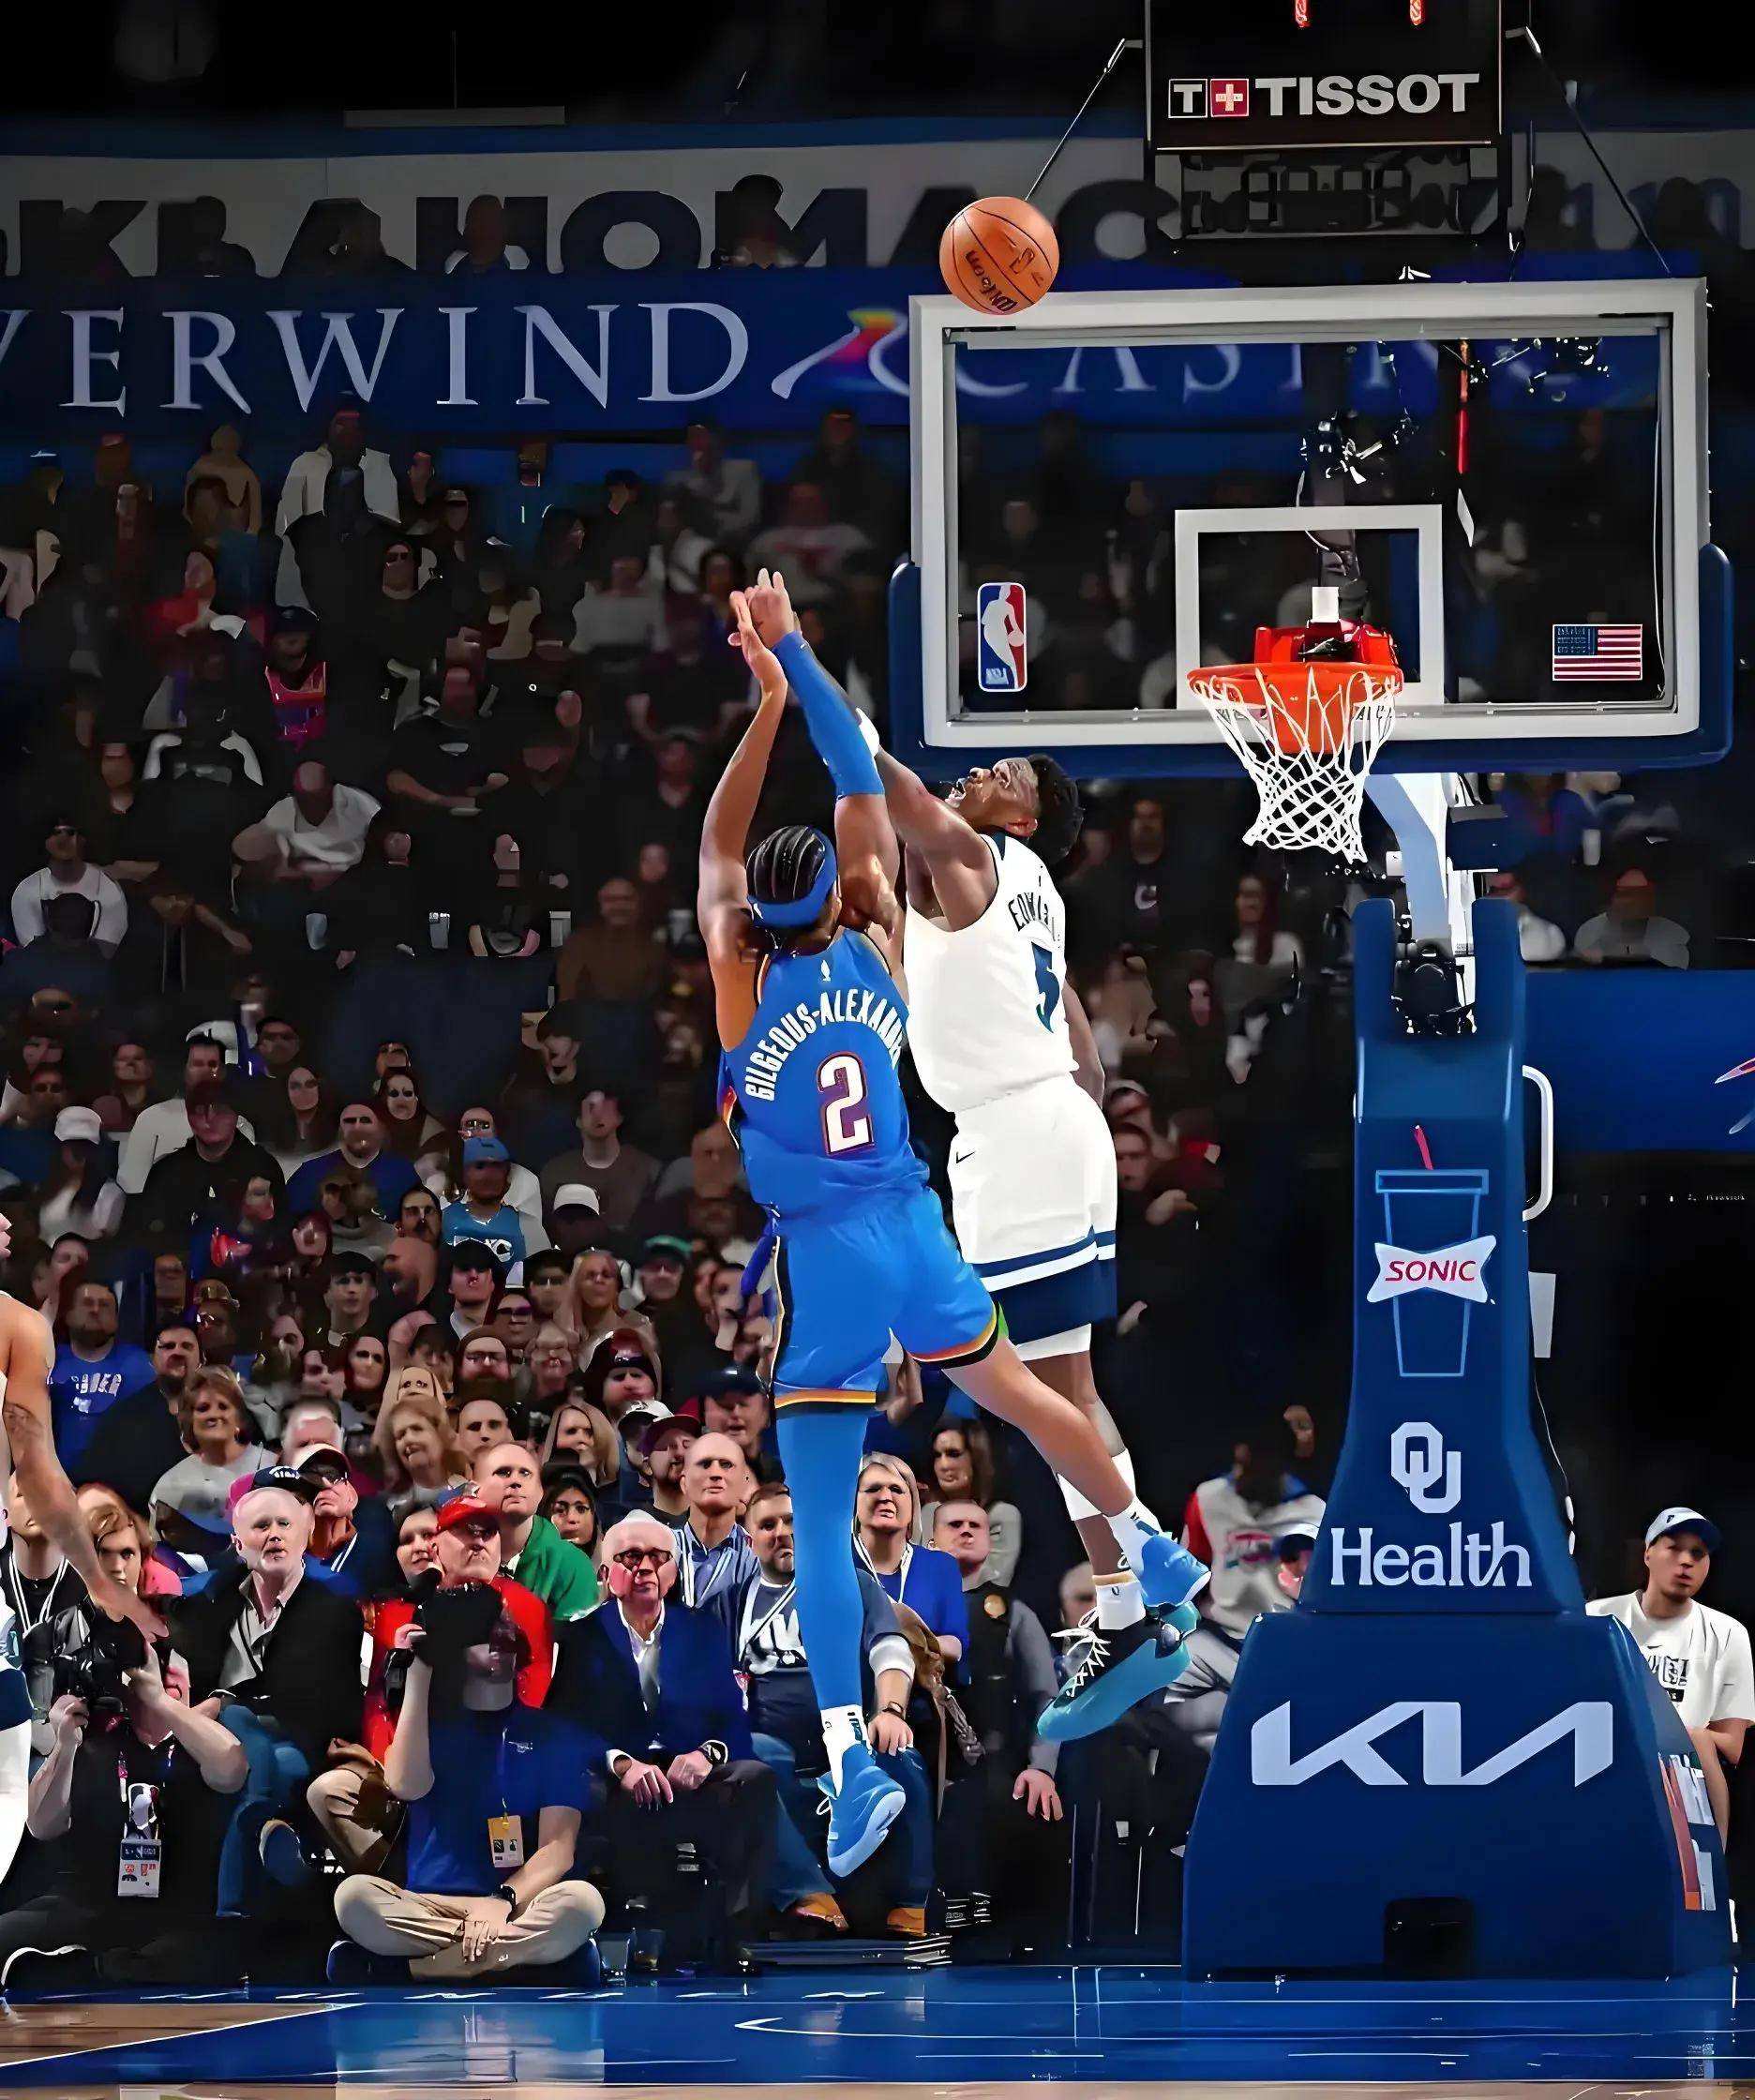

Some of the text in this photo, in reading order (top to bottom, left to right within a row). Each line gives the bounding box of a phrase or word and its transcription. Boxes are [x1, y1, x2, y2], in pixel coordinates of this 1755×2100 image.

[1254, 73, 1479, 116] TISSOT
[0, 184, 984, 279] KLAHOMA
[817, 1051, 875, 1156] 2
[1385, 1260, 1477, 1282] SONIC
[1391, 1421, 1462, 1513] OU
[1330, 1521, 1533, 1587] Health
[1251, 1700, 1613, 1788] KIA
